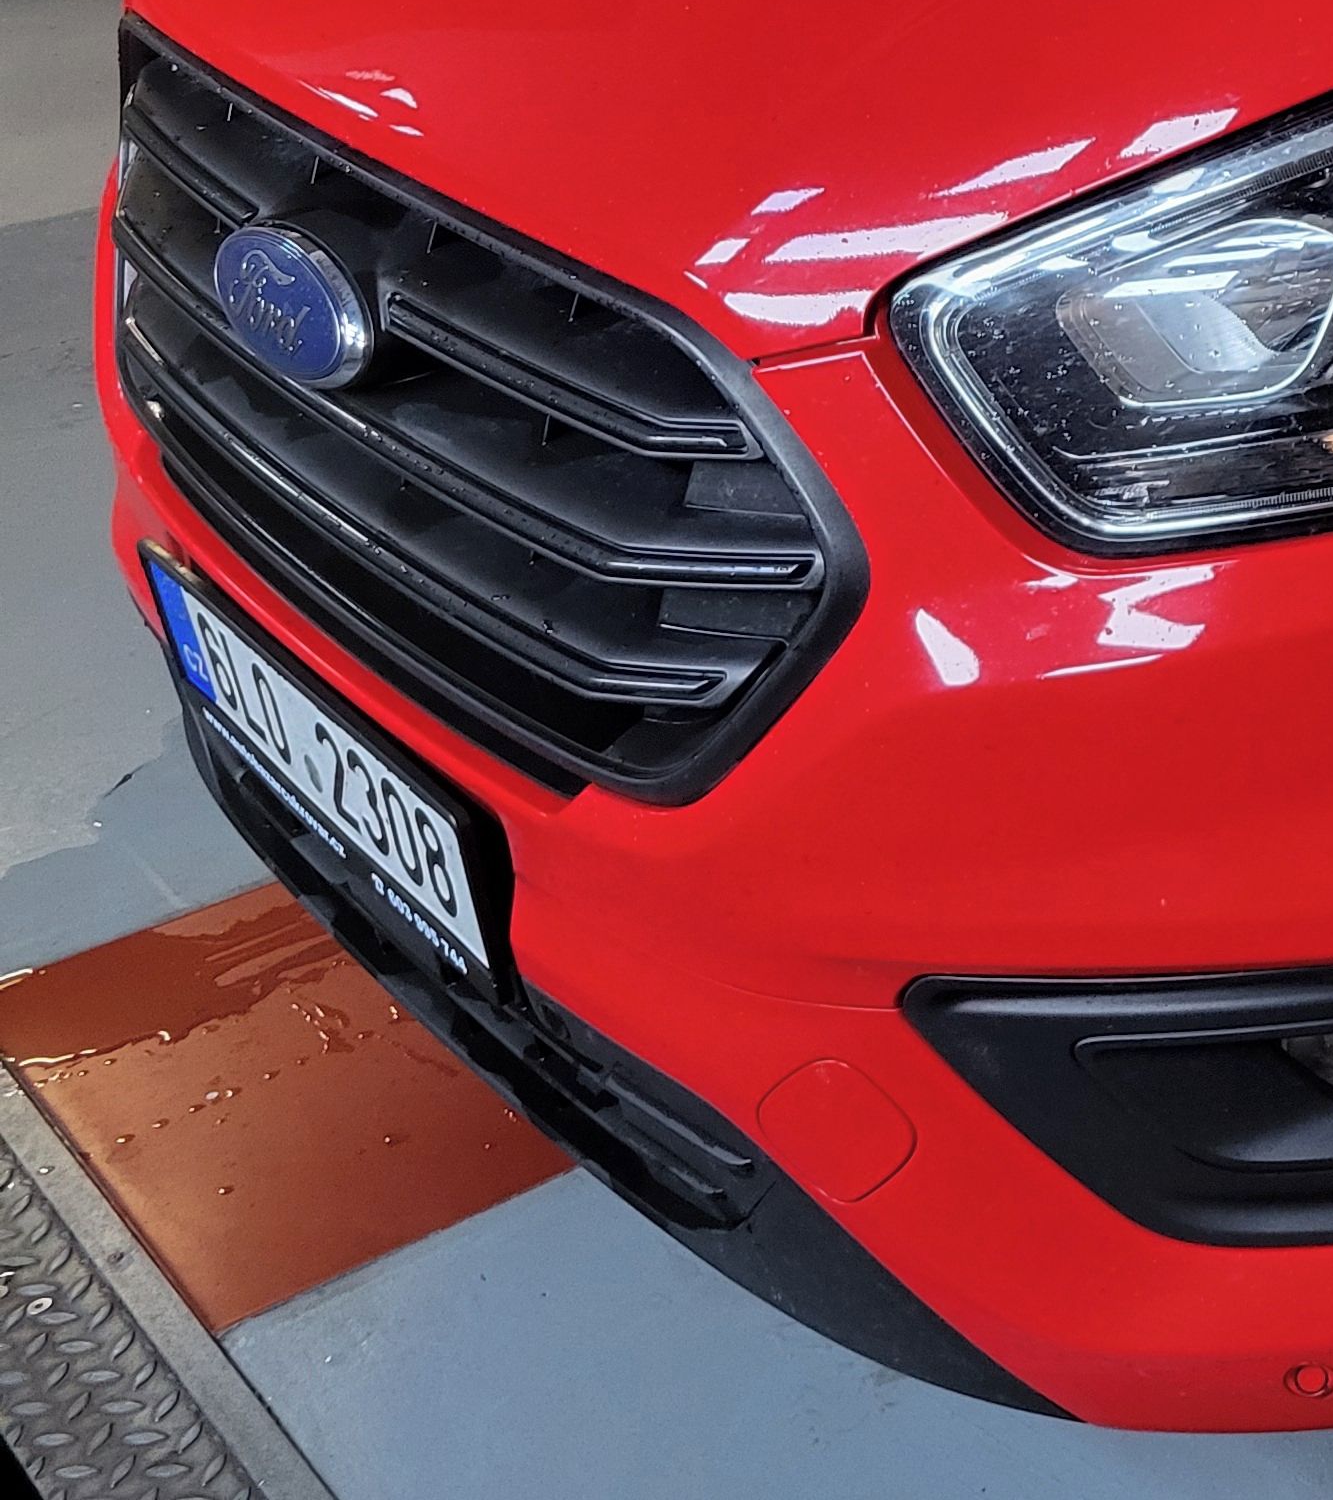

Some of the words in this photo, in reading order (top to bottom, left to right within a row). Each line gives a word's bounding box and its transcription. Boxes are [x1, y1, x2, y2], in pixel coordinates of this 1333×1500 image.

[230, 249, 311, 356] Ford
[183, 643, 209, 683] CZ
[315, 722, 458, 918] 2308
